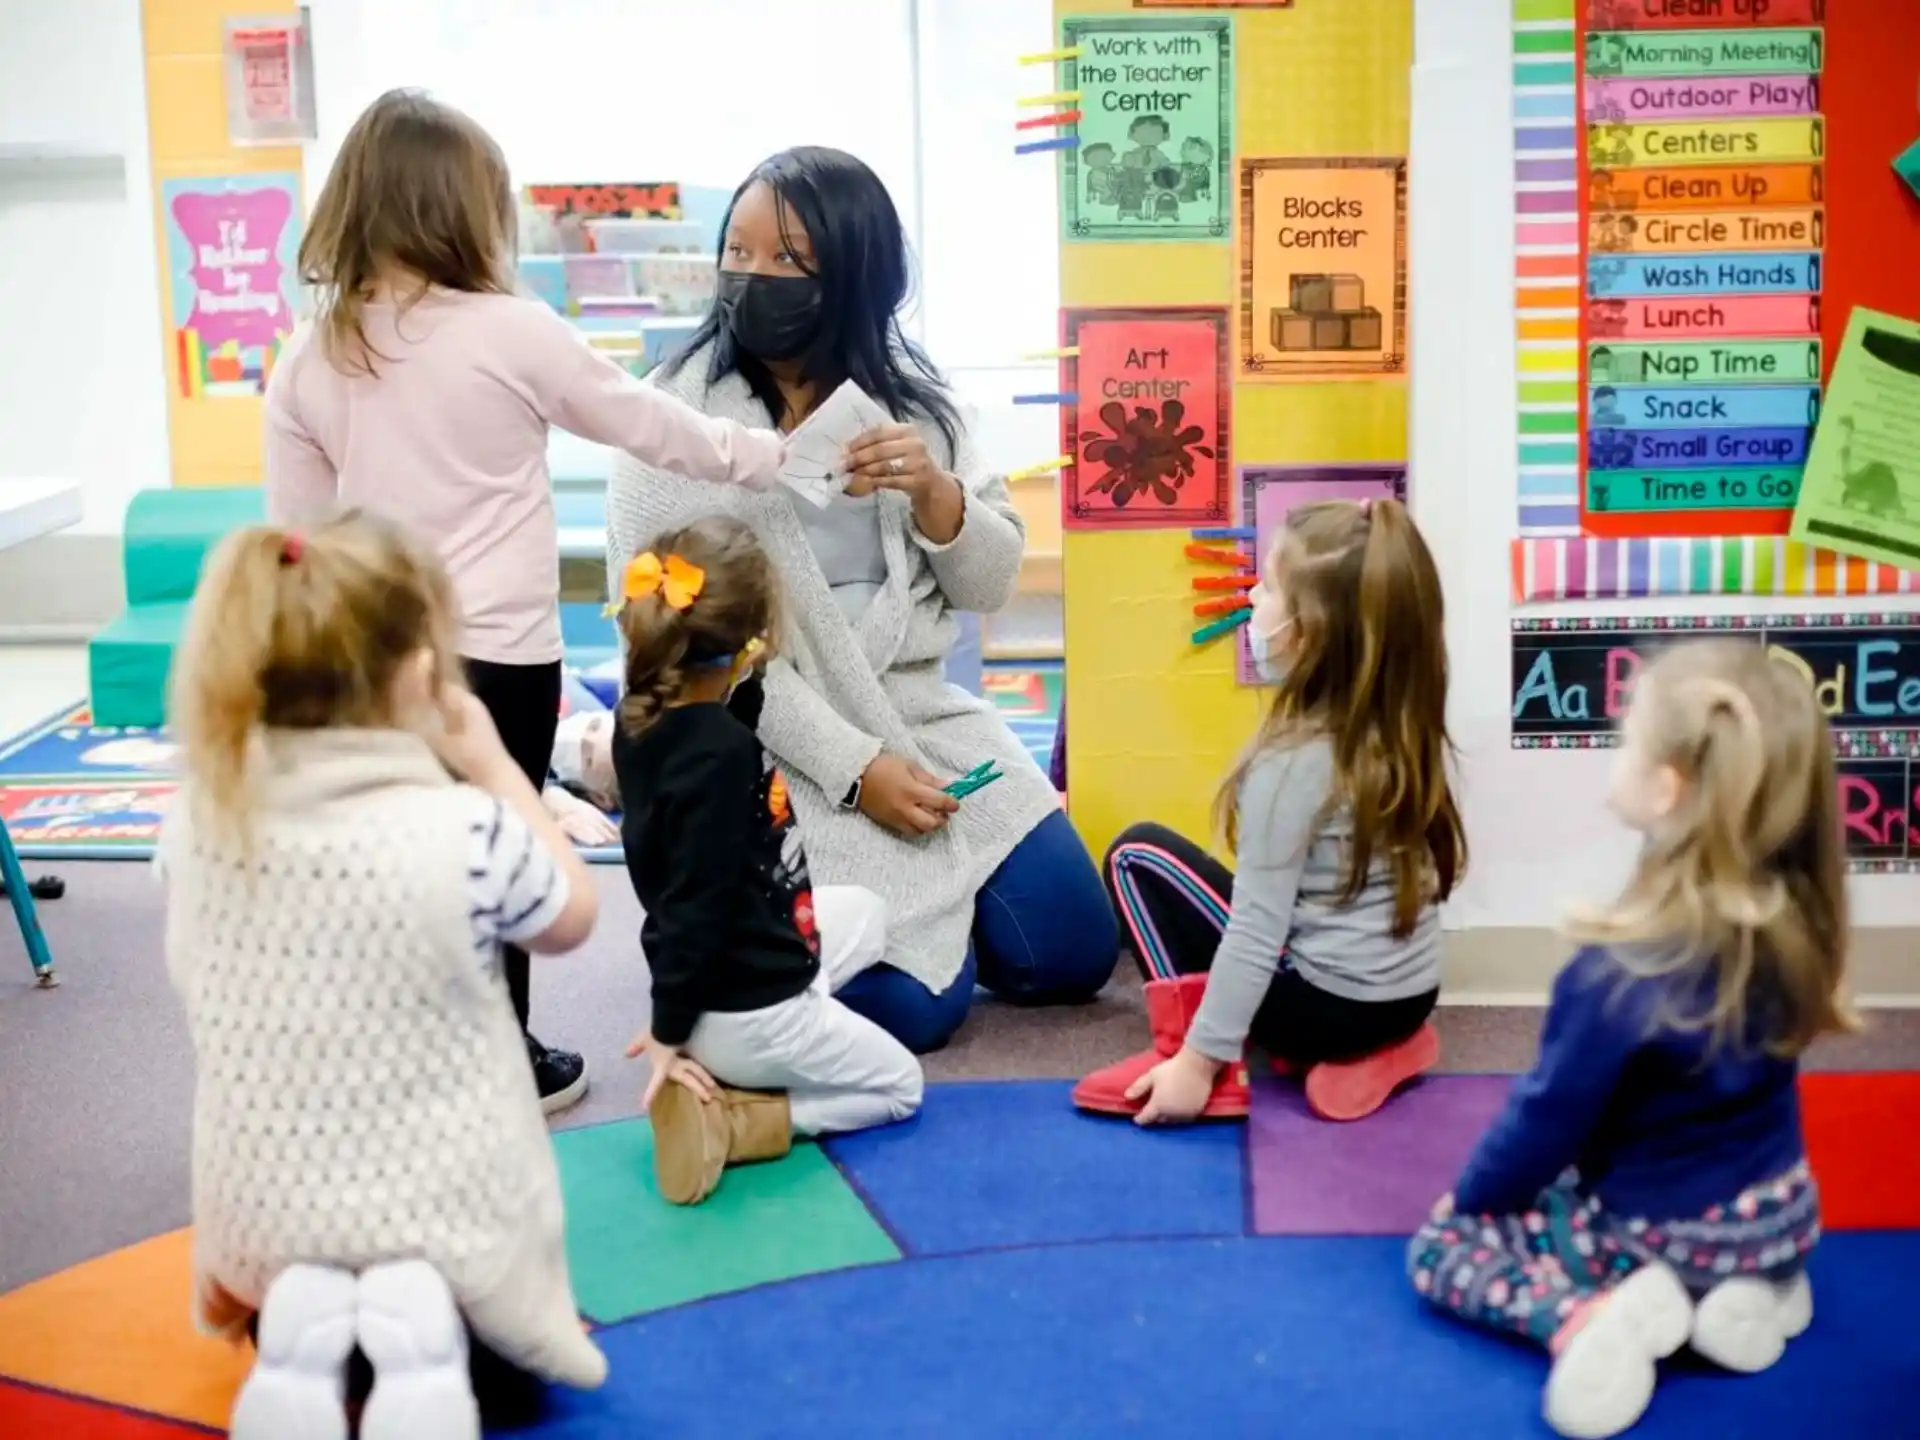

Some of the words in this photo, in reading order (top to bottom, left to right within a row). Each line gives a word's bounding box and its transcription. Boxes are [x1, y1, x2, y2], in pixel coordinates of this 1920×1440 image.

[1643, 0, 1722, 18] Clean
[1734, 0, 1769, 22] Up
[1092, 37, 1147, 56] Work
[1154, 36, 1201, 56] with
[1625, 44, 1713, 65] Morning
[1720, 41, 1808, 64] Meeting
[1080, 65, 1117, 83] the
[1121, 63, 1211, 83] Teacher
[1101, 90, 1192, 112] Center
[1630, 86, 1740, 110] Outdoor
[1749, 82, 1808, 107] Play
[1643, 130, 1759, 155] Centers
[1643, 175, 1721, 200] Clean
[1732, 173, 1768, 202] Up
[1283, 196, 1363, 219] Blocks
[1278, 226, 1368, 249] Center
[1644, 218, 1728, 244] Circle
[1739, 216, 1807, 242] Time
[1642, 265, 1710, 288] Wash
[1718, 263, 1797, 286] Hands
[1643, 304, 1725, 328] Lunch
[1124, 347, 1169, 370] Art
[1641, 350, 1699, 380] Nap
[1710, 350, 1778, 374] Time
[1102, 377, 1191, 400] Center
[1643, 394, 1728, 420] Snack
[1641, 434, 1707, 459] Small
[1716, 434, 1794, 462] Group
[1640, 477, 1706, 501] Time
[1717, 476, 1746, 499] to
[1757, 475, 1794, 499] Go
[1512, 648, 1590, 720] Aa
[1855, 639, 1920, 716] Ee
